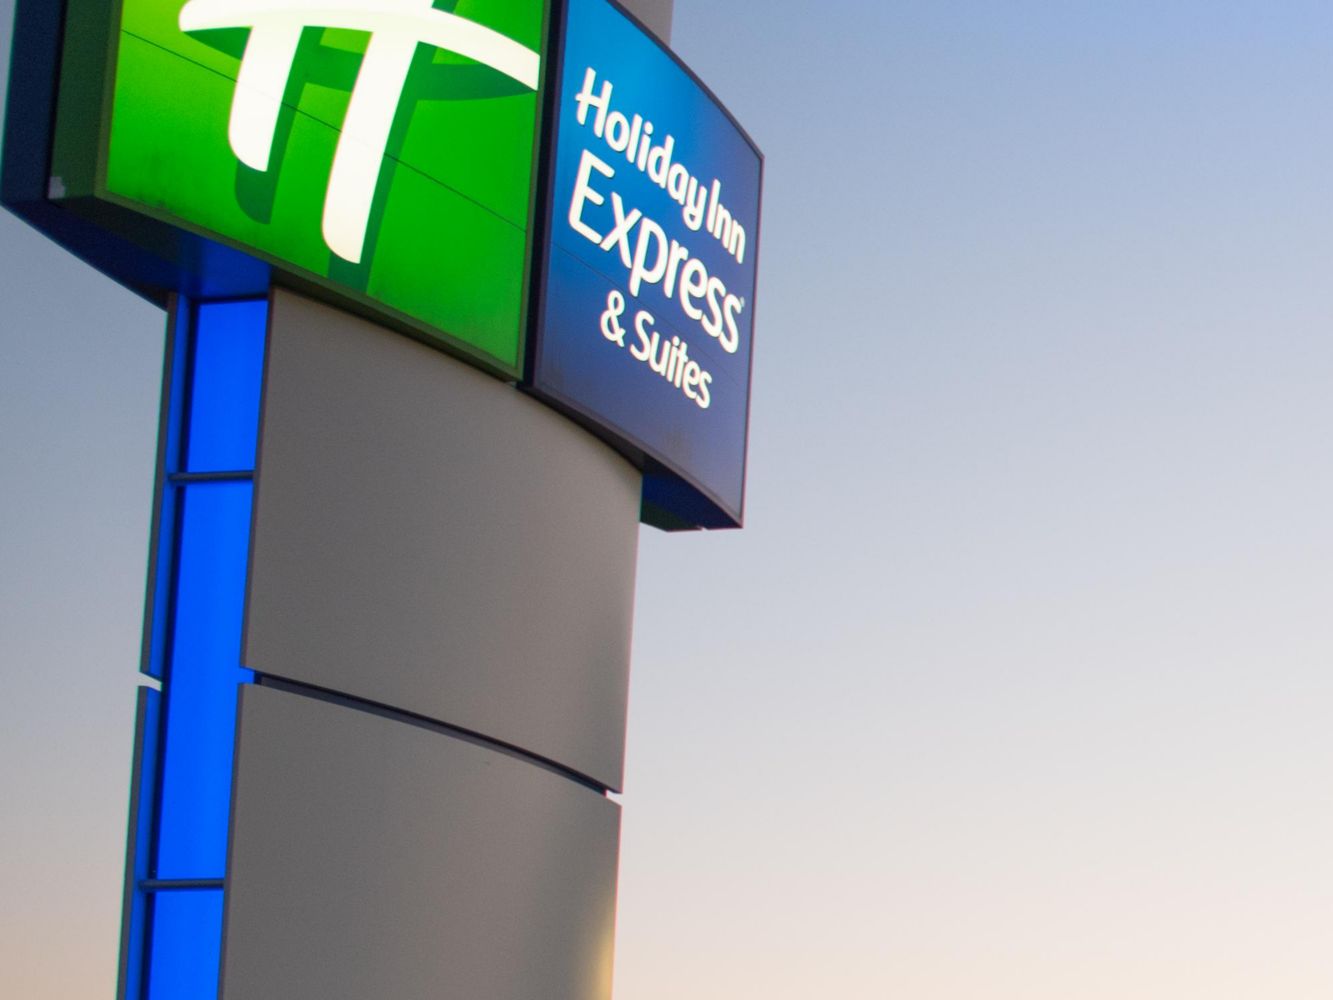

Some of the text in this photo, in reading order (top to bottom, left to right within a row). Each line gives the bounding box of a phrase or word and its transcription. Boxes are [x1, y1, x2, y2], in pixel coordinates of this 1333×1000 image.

[568, 149, 744, 354] Express
[575, 67, 746, 265] Holiday Inn
[600, 290, 713, 409] & Suites
